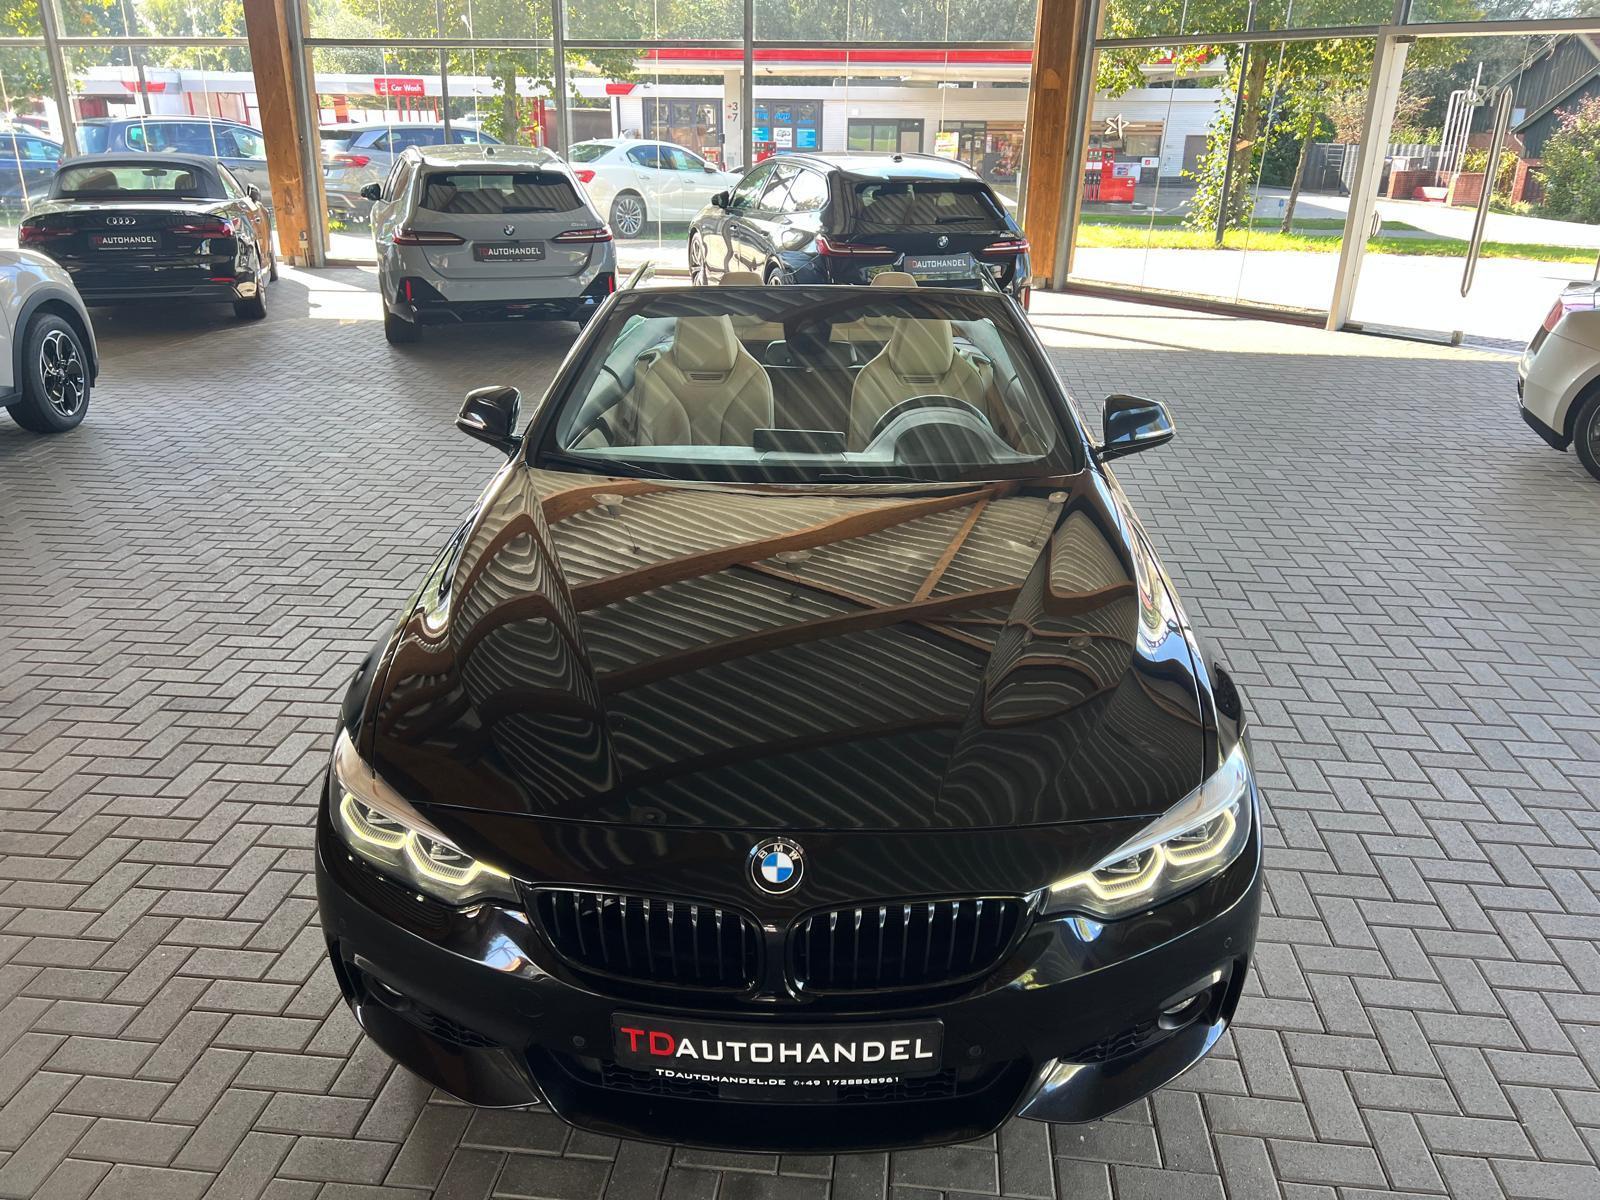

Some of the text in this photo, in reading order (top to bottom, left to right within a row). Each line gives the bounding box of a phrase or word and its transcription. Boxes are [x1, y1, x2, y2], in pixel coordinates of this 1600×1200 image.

[732, 102, 738, 111] 3
[732, 112, 738, 122] 7
[757, 844, 801, 861] BMW
[620, 1027, 933, 1063] TDAUTOHANDEL
[655, 1068, 786, 1086] TDAUTOHANDEL.DE
